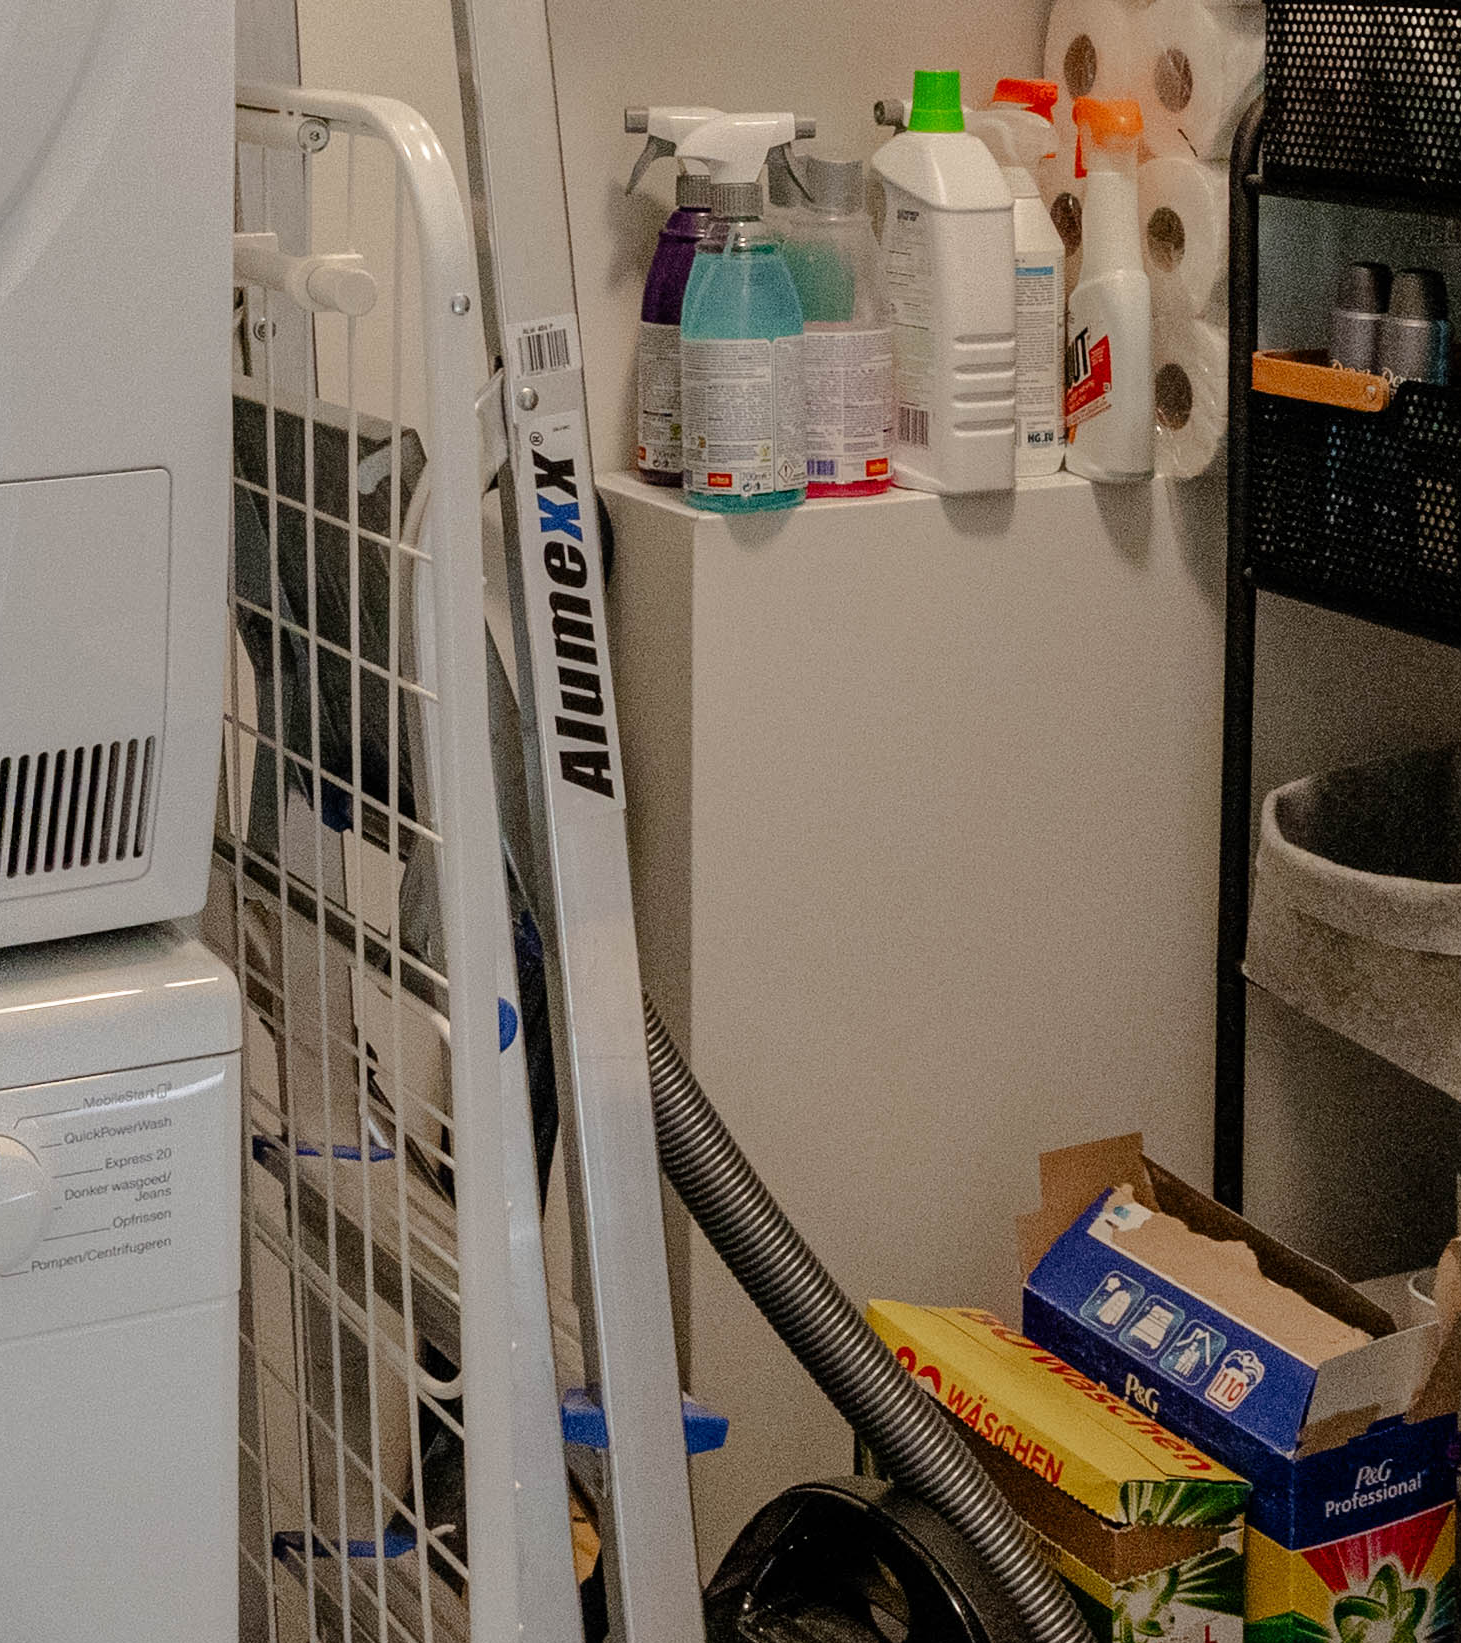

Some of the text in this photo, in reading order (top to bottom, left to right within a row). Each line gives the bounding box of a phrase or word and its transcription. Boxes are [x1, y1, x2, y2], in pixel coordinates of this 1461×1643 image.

[531, 449, 616, 800] Alumexx
[83, 1087, 154, 1108] MobileStart
[64, 1117, 172, 1144] QuickPowerWash
[105, 1147, 172, 1170] Express 20
[65, 1172, 172, 1201] Donker wasgoed/
[135, 1187, 172, 1202] Jeans
[113, 1210, 172, 1230] Opfrissen
[31, 1237, 172, 1273] Pompen/Centrifugeren
[1125, 1373, 1160, 1414] P&G
[1216, 1372, 1244, 1402] 110
[948, 1383, 1065, 1487] WÄSCHEN
[1355, 1458, 1393, 1490] P&G
[1325, 1473, 1423, 1518] Professional
